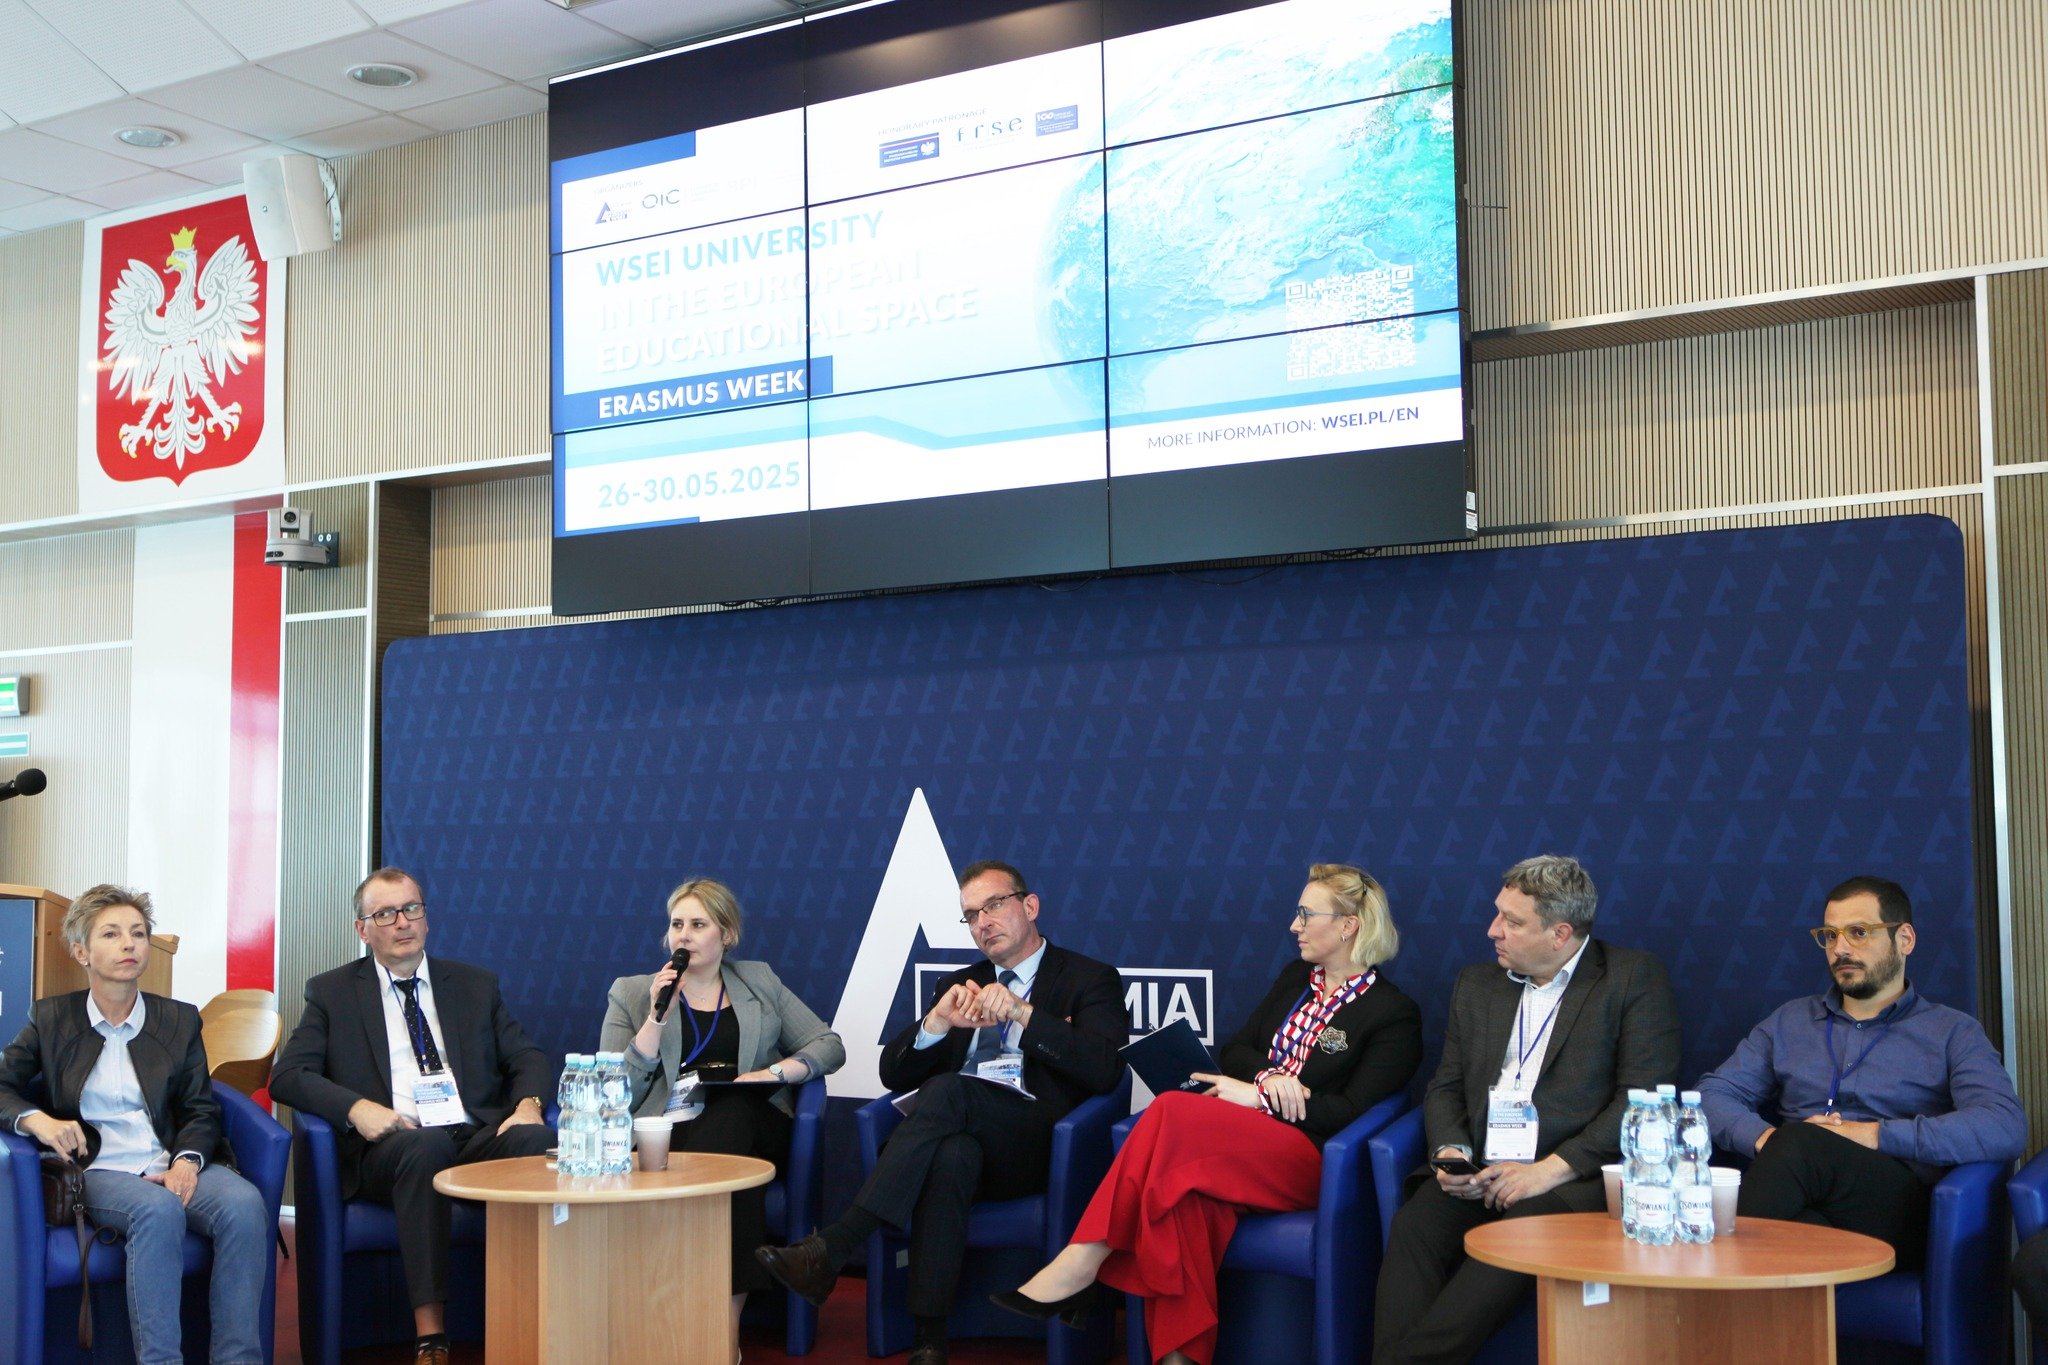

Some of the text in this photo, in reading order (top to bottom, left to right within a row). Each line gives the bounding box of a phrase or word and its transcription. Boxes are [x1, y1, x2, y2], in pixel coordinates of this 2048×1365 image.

[932, 108, 988, 125] PATRONAGE
[642, 189, 680, 209] OIC
[596, 249, 670, 286] WSEI
[683, 210, 884, 271] UNIVERSITY
[597, 249, 924, 331] IN THE EUROPEAN
[597, 288, 980, 374] EDUCATIONAL SPACE
[598, 369, 805, 419] ERASMUS WEEK
[1148, 406, 1420, 448] MORE INFORMATION: WSEI.PL/EN
[598, 461, 801, 509] 26-30.05.2025
